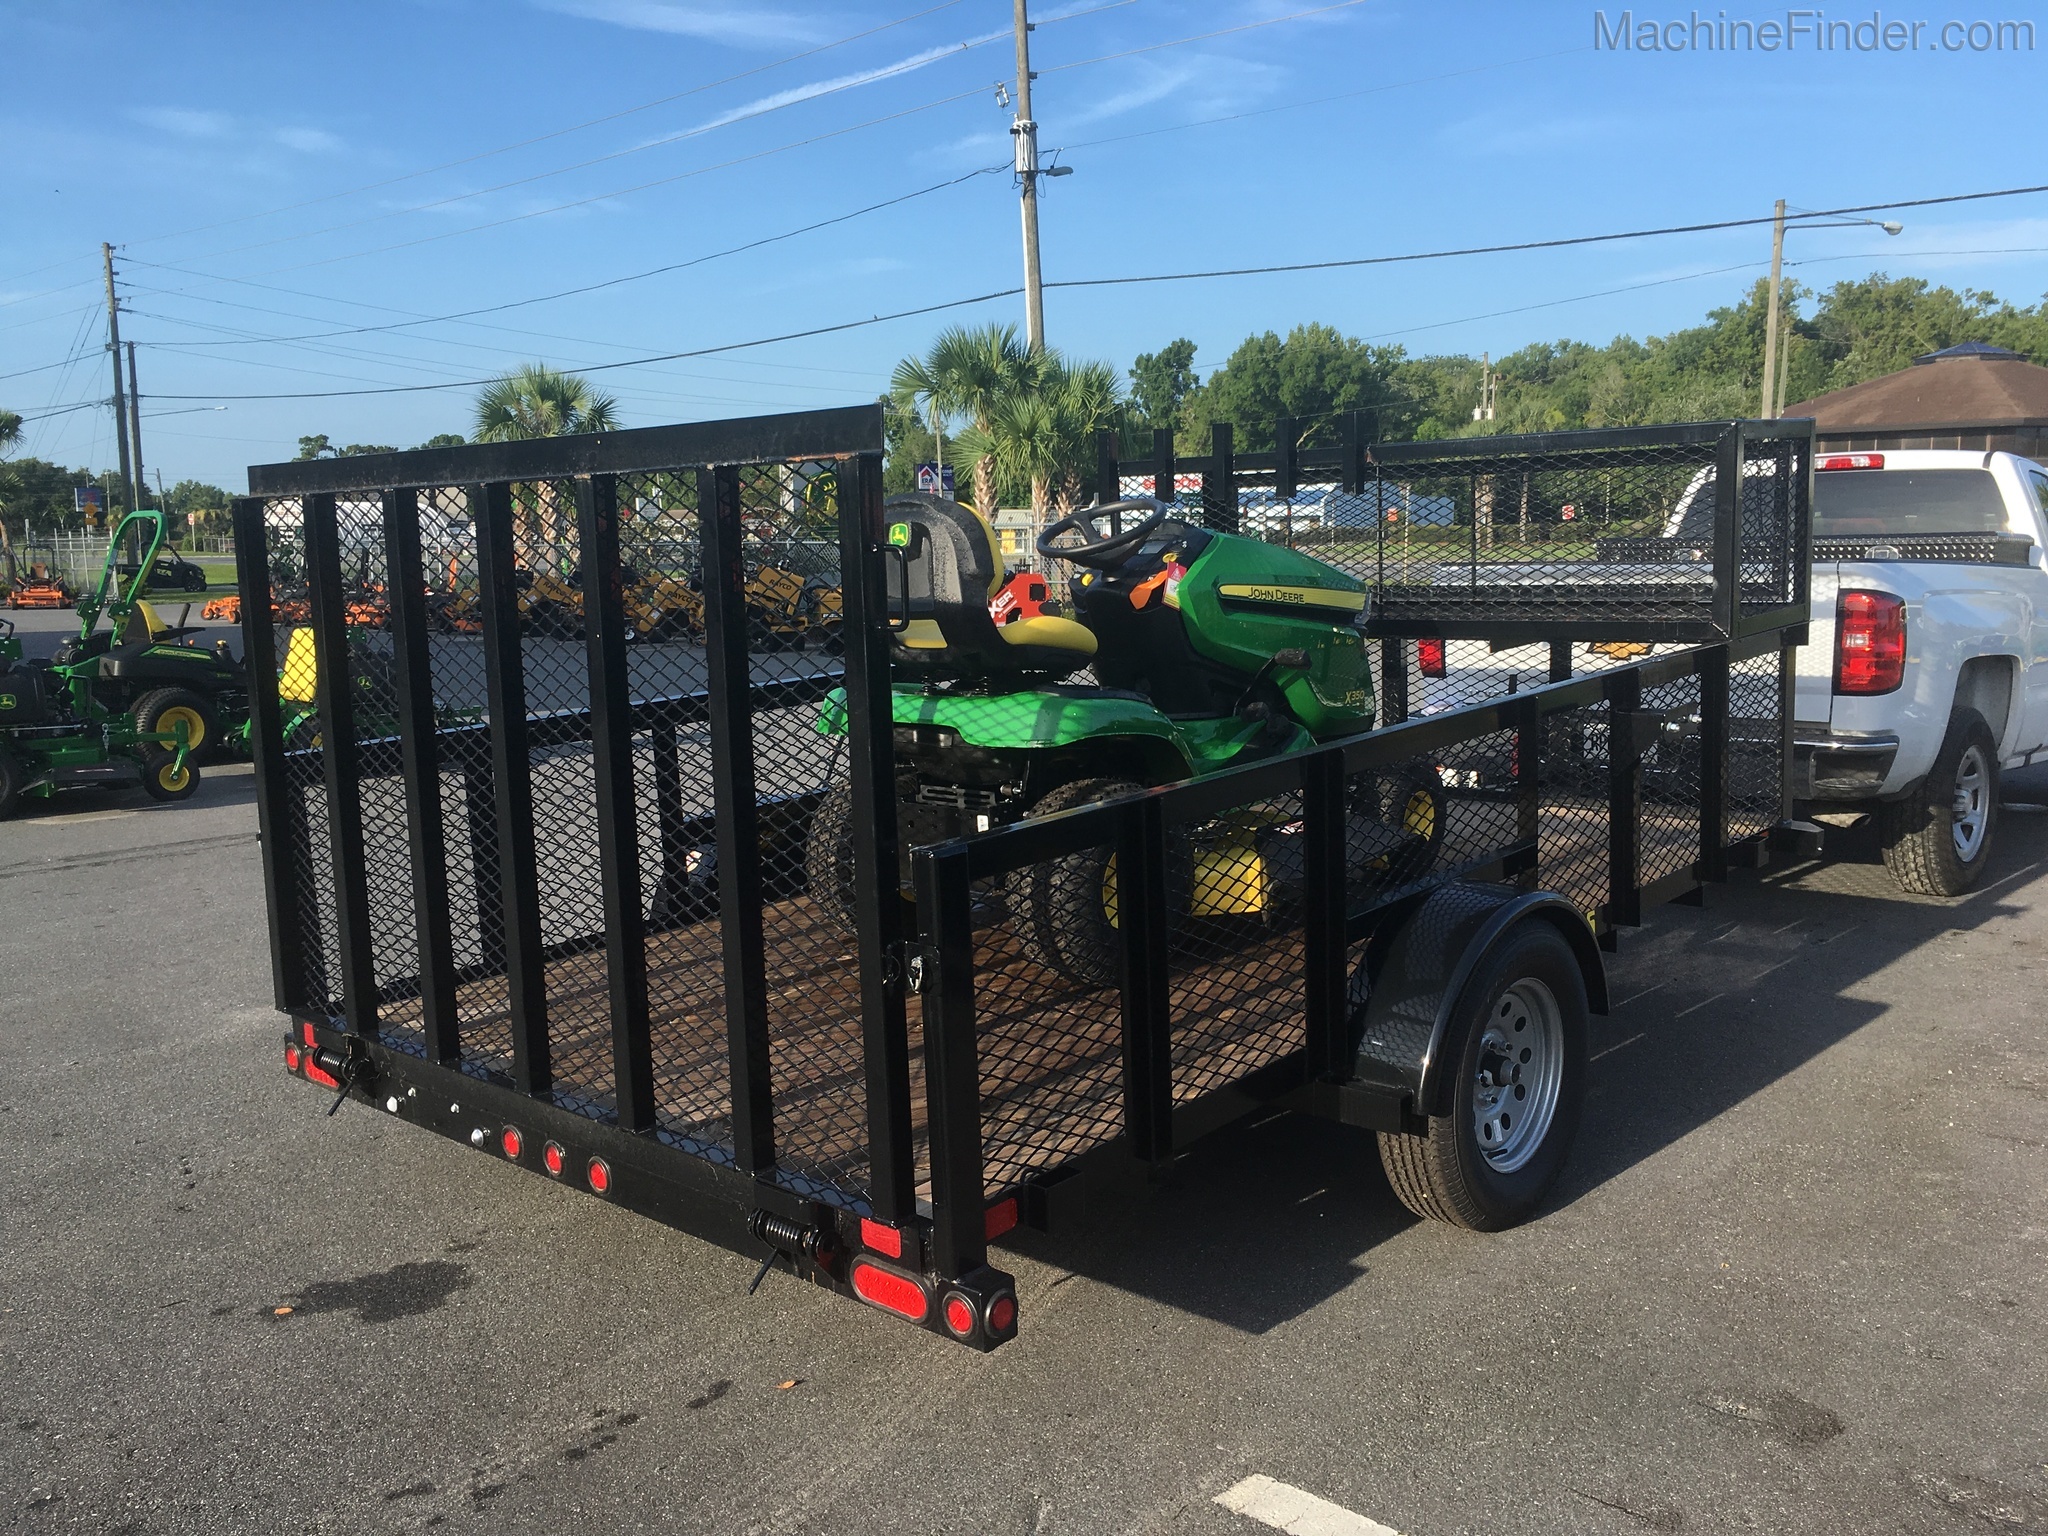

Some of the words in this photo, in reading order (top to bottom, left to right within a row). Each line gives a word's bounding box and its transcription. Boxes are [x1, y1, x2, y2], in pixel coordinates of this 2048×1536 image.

[1248, 587, 1274, 599] JOHN
[1275, 590, 1304, 602] DEERE
[1344, 690, 1365, 704] X350
